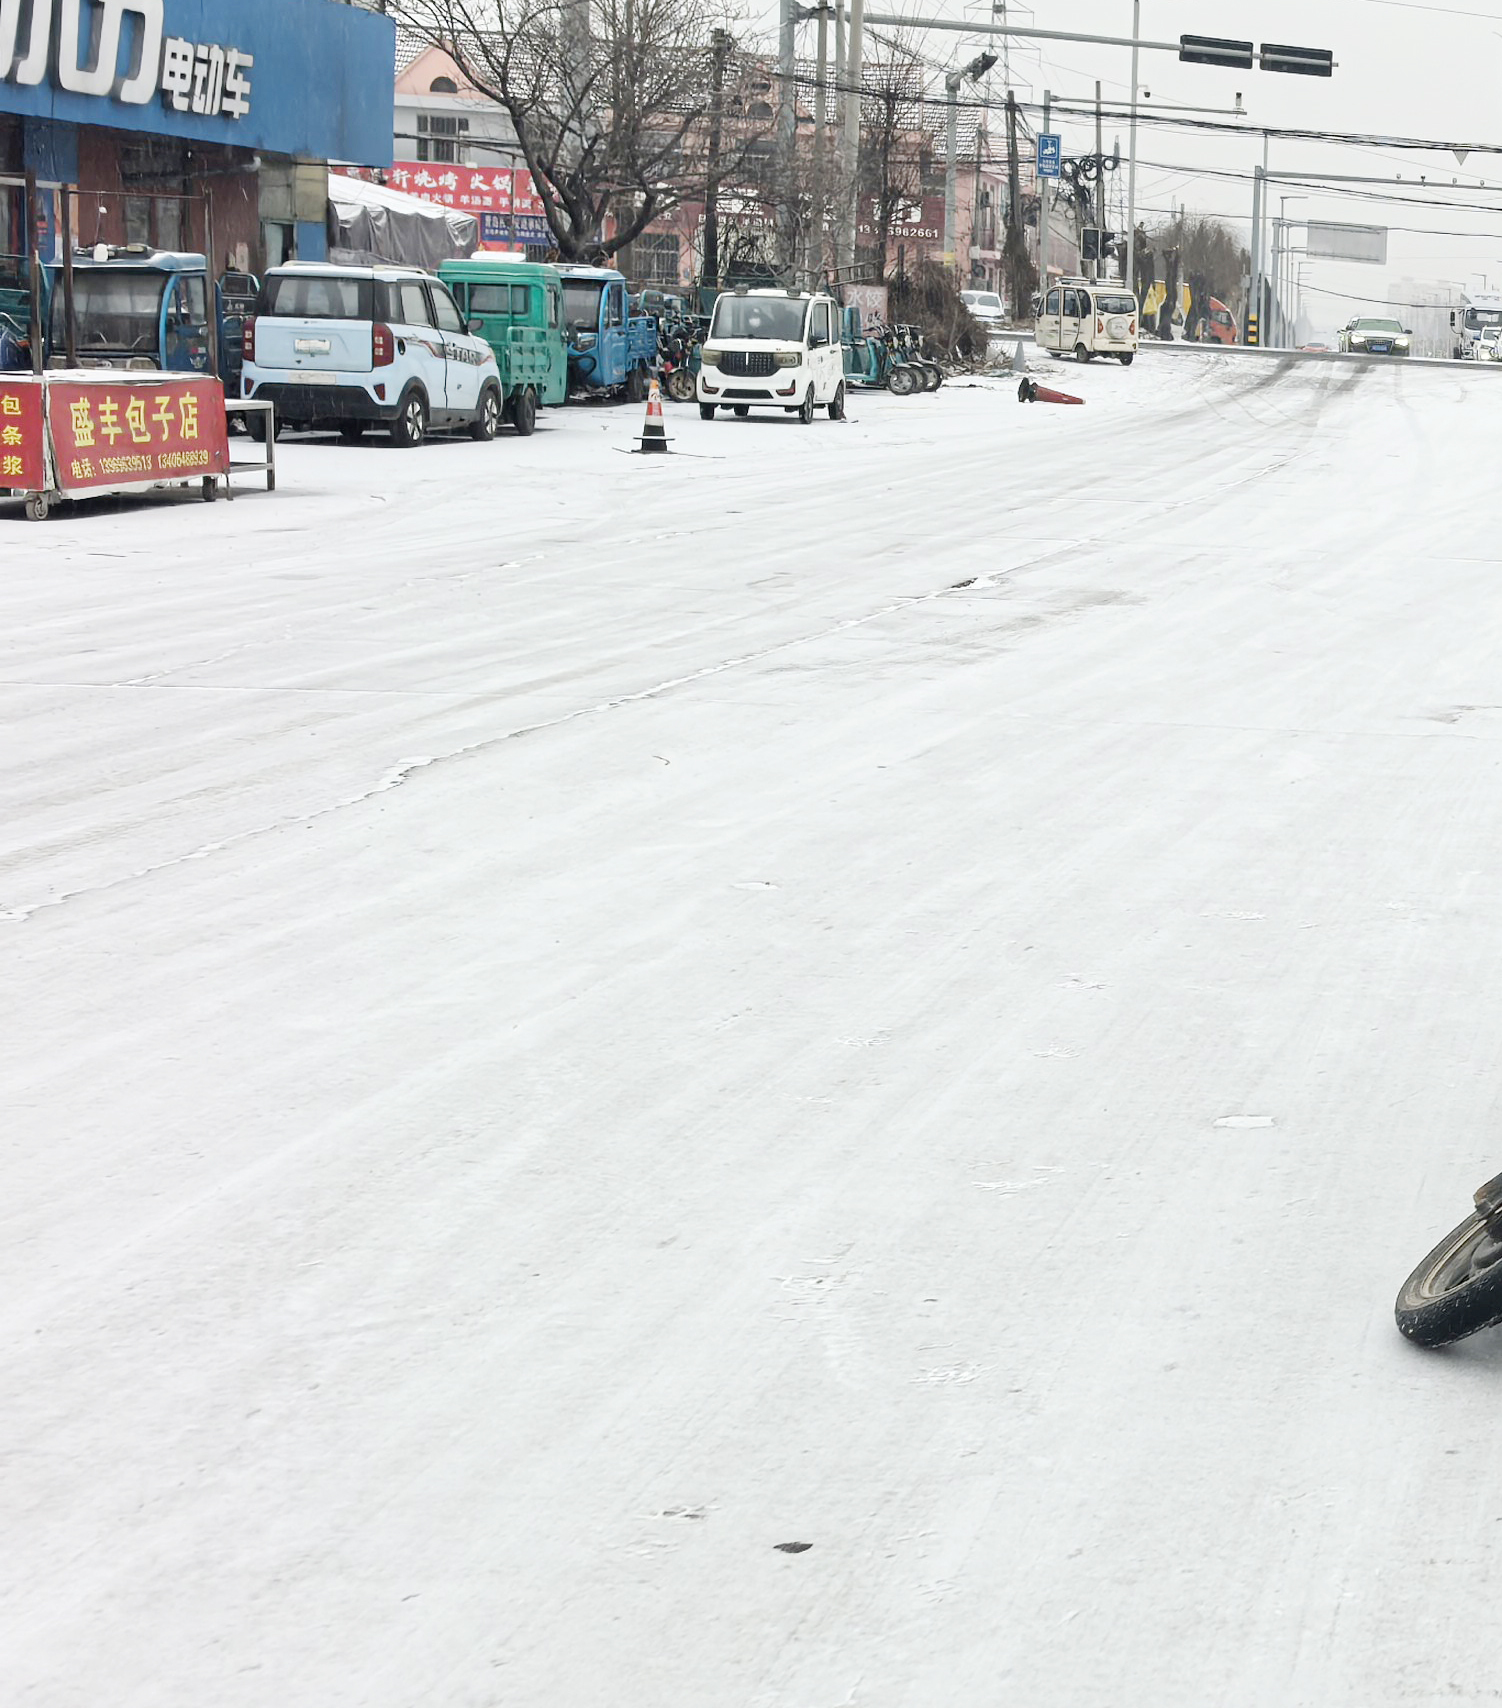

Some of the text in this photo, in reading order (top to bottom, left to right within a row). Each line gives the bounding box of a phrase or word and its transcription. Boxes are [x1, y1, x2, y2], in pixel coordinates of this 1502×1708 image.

[162, 37, 254, 119] 电动车
[70, 391, 199, 448] 盛丰包子店
